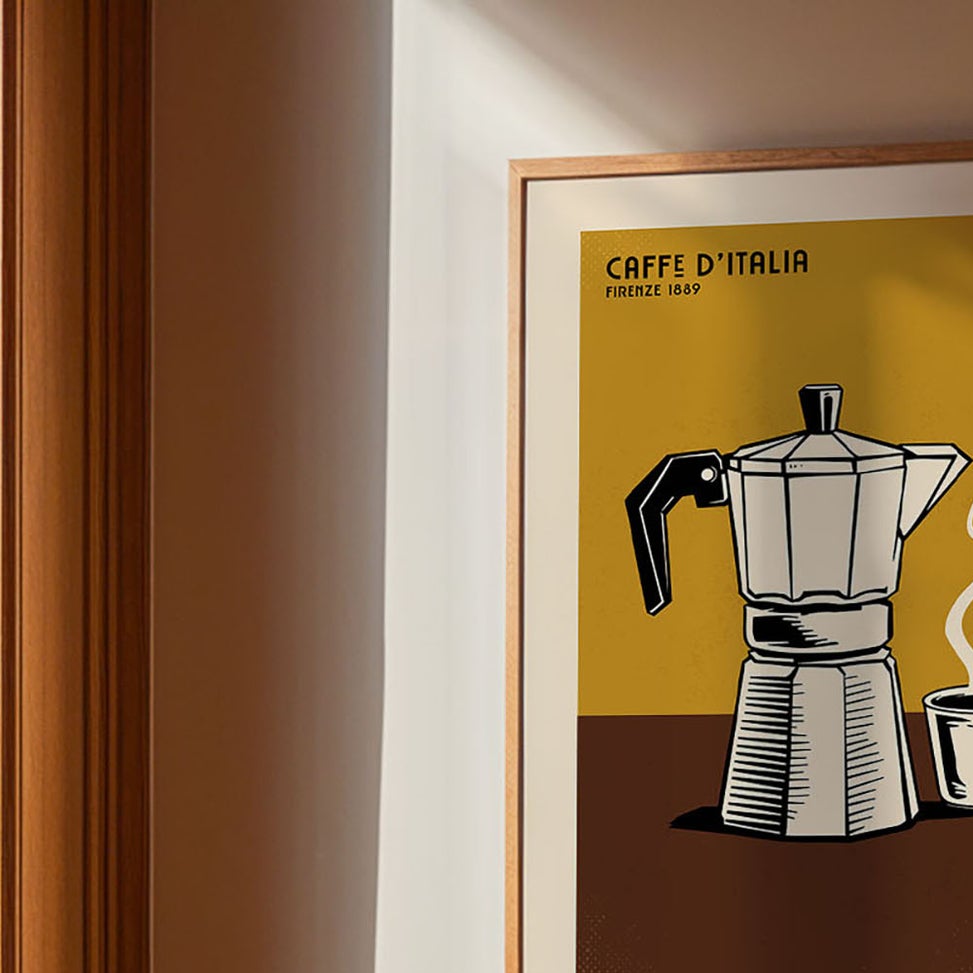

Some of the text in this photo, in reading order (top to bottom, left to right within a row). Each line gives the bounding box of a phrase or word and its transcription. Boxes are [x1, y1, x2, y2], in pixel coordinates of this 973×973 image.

[606, 249, 808, 280] CAFFE D’ITALIA
[605, 283, 701, 298] FIRENZE 1889
